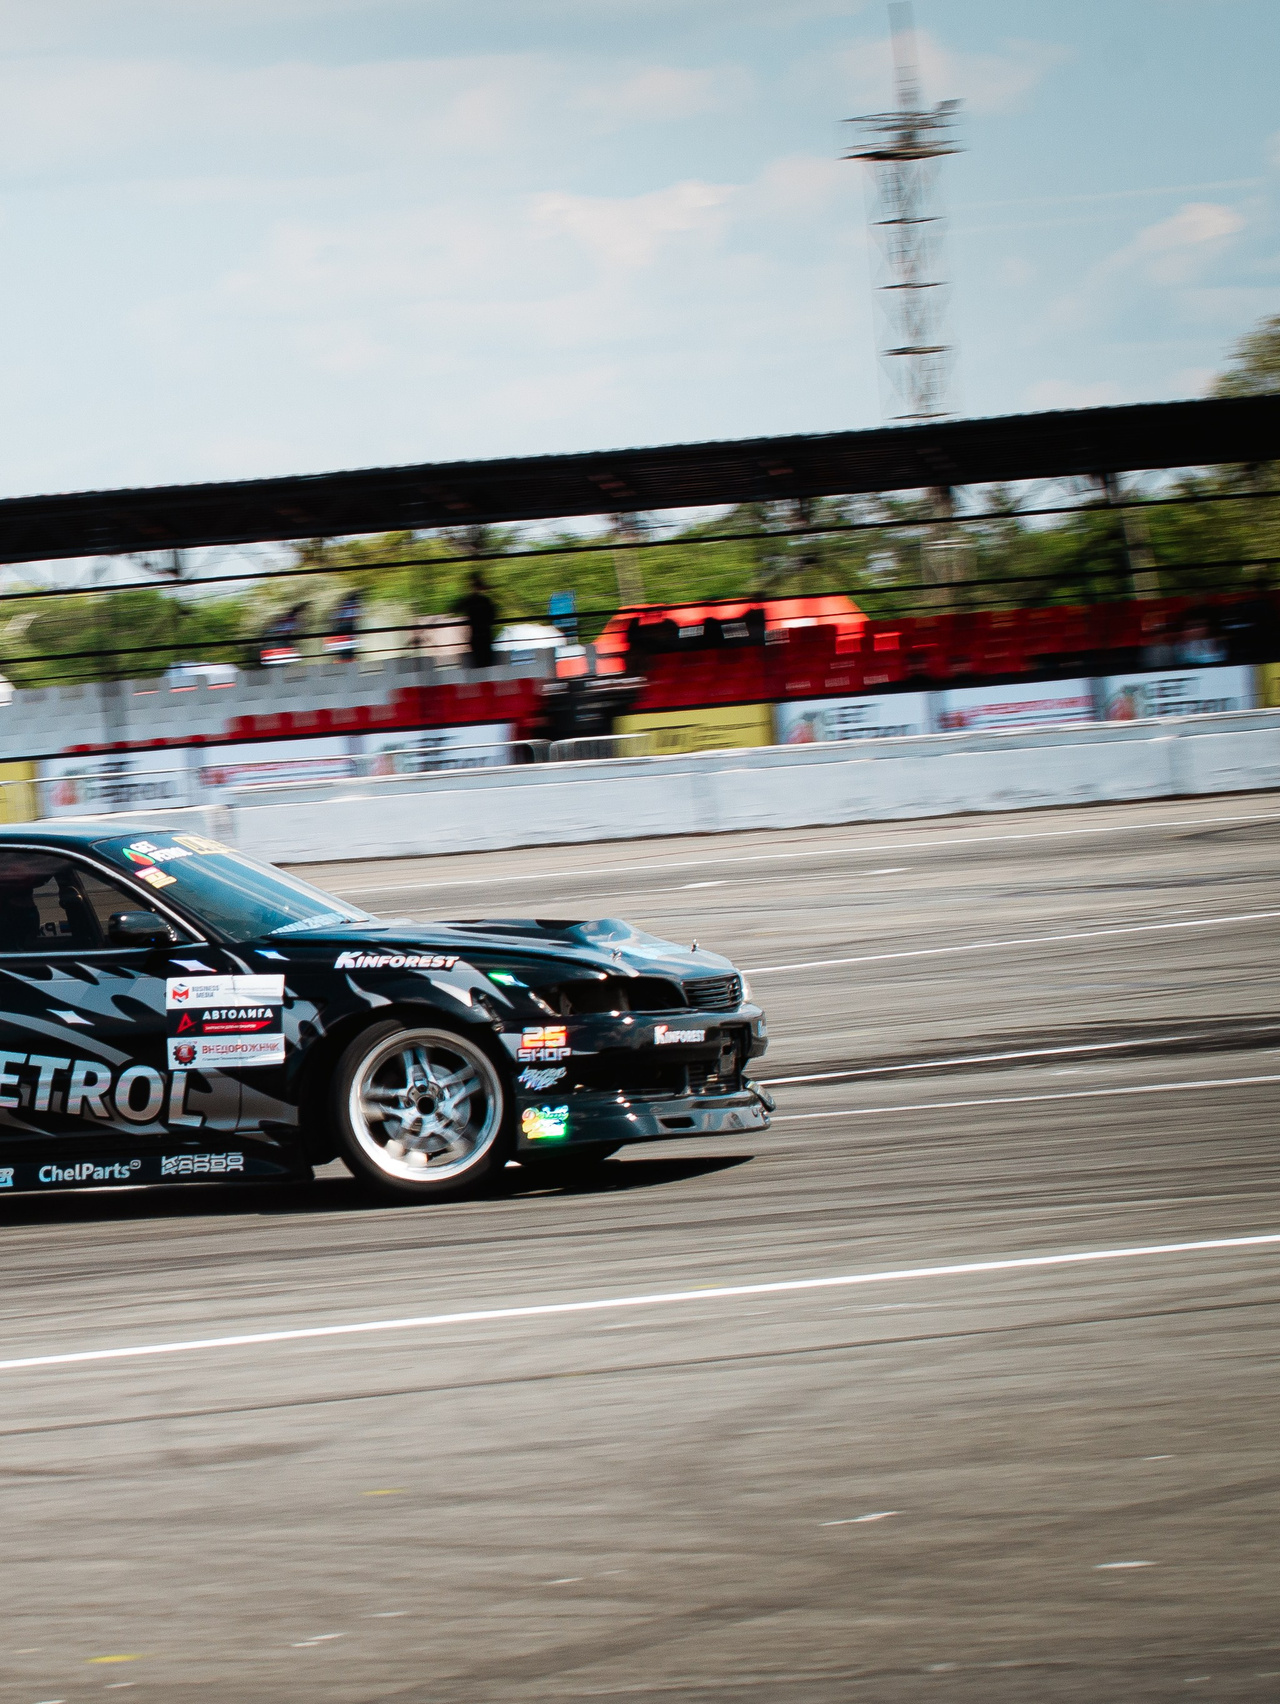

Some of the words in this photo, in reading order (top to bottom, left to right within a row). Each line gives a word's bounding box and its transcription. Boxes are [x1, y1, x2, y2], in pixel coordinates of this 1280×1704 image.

[202, 1008, 274, 1020] АВТОЛИГА
[521, 1026, 567, 1048] 25
[201, 1043, 280, 1055] ВНЕДОРОЖНИК
[517, 1048, 572, 1062] SHOP
